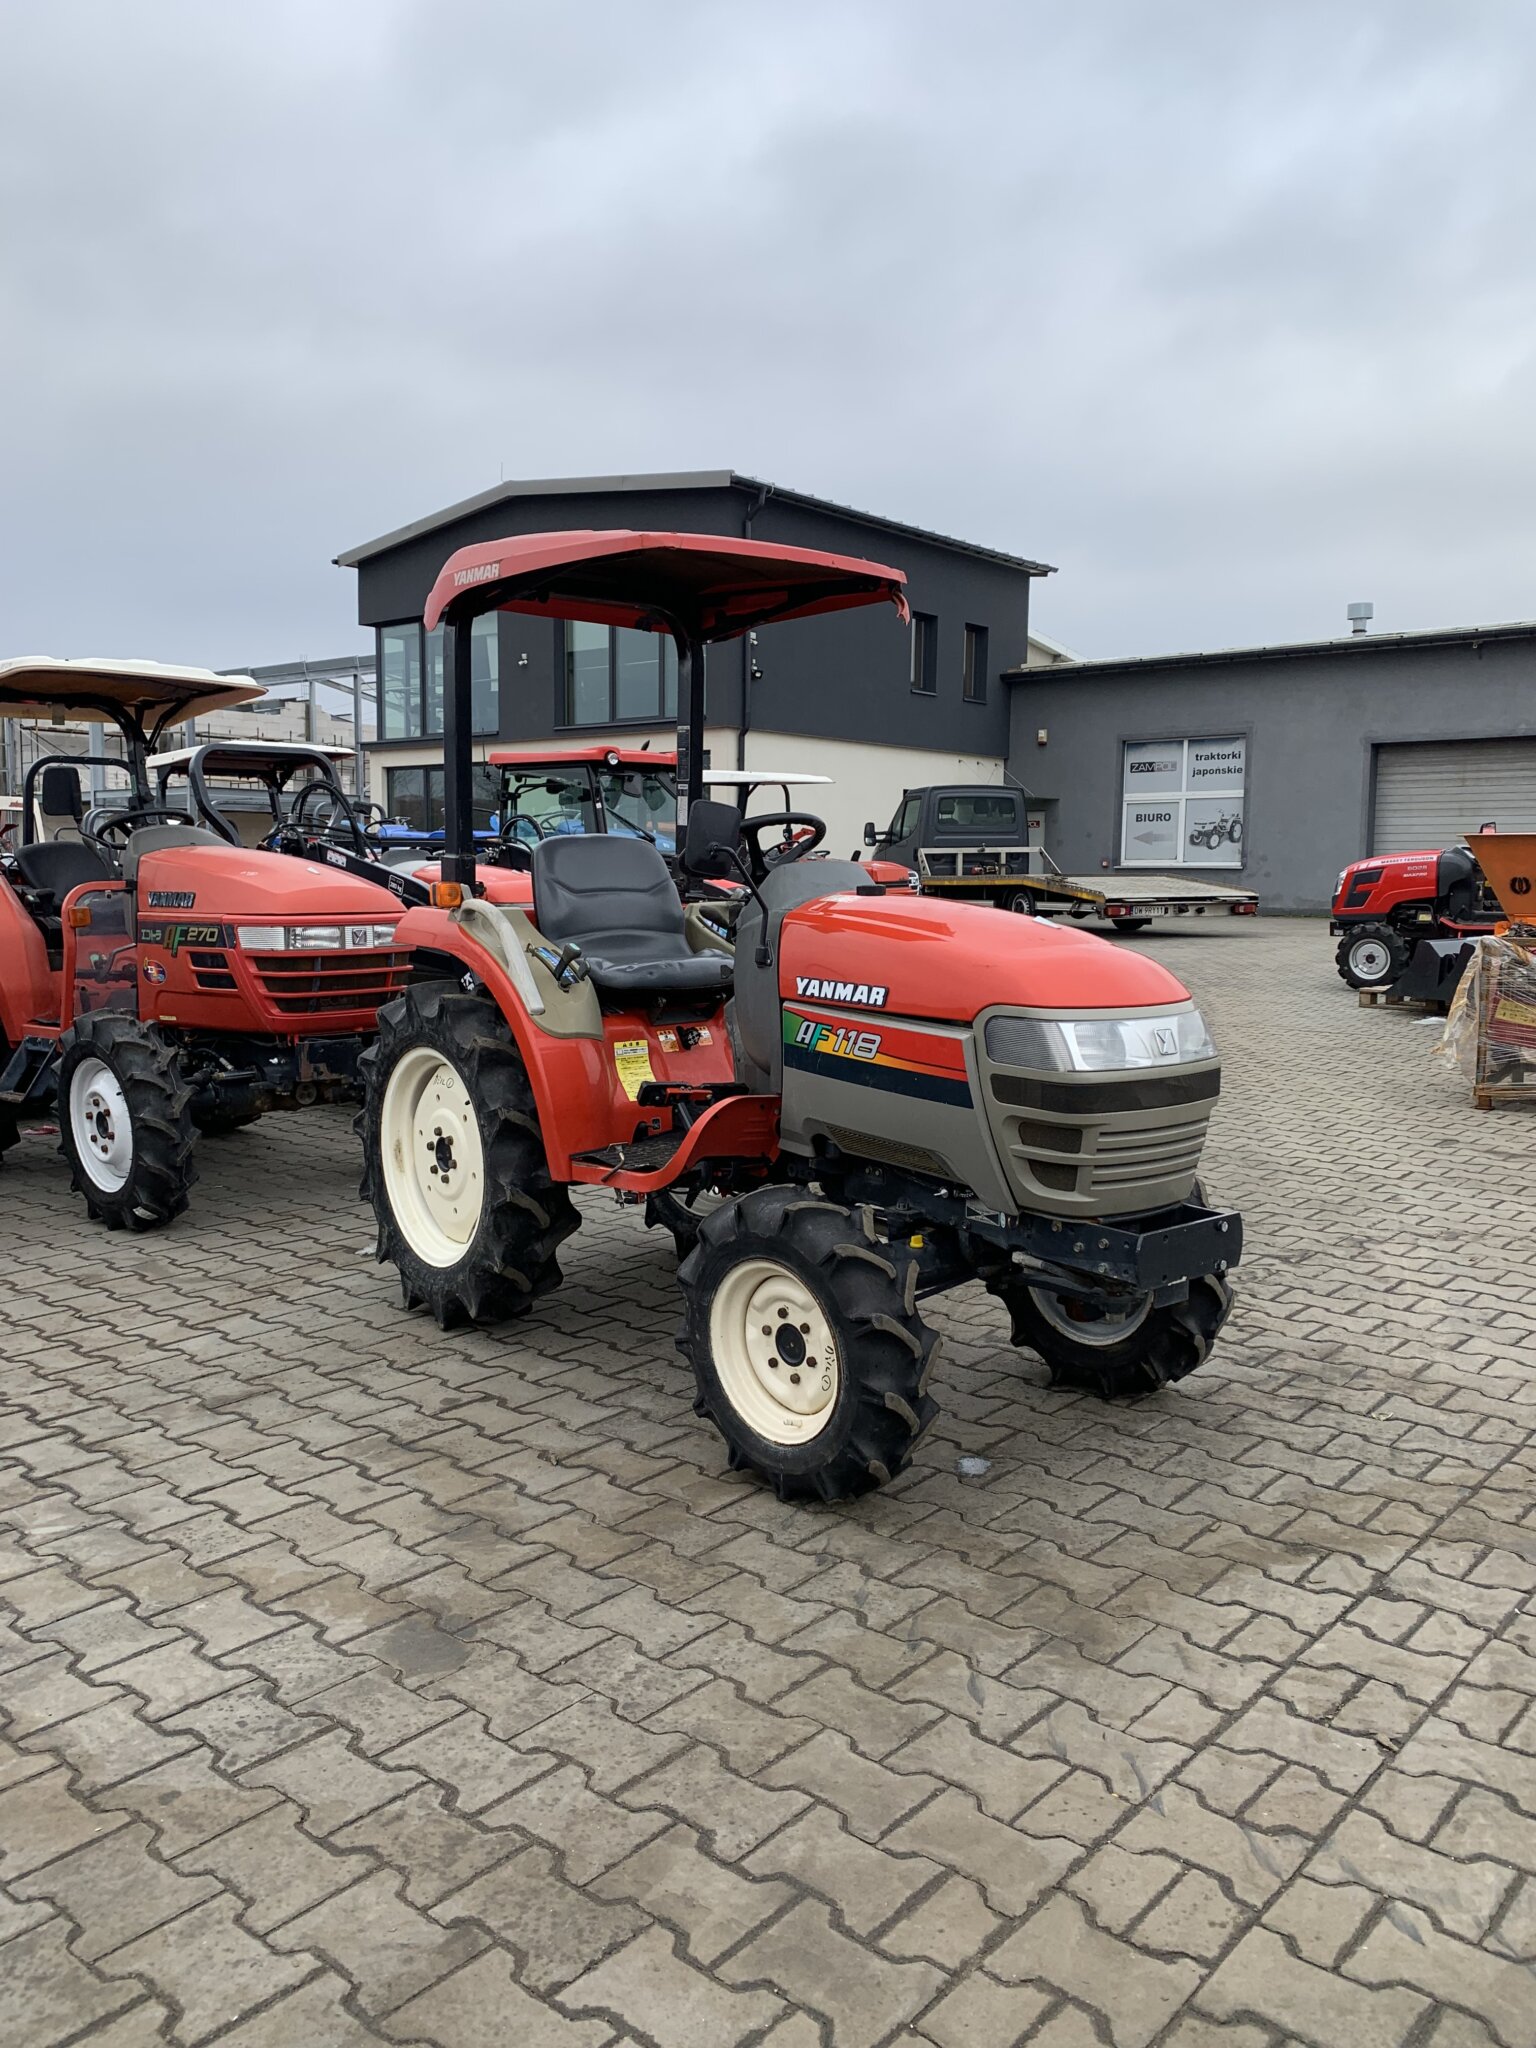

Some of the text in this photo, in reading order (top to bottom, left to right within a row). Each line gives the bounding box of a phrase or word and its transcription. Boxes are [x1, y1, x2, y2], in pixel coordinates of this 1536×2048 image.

[453, 563, 500, 586] YANMAR
[1195, 750, 1241, 761] traktorki
[1130, 761, 1177, 773] ZAMPOL
[1192, 765, 1243, 778] japońskie
[1135, 812, 1172, 823] BIURO
[148, 890, 195, 908] YANMAR
[795, 976, 887, 1007] YANMAR
[795, 1019, 882, 1060] AF118
